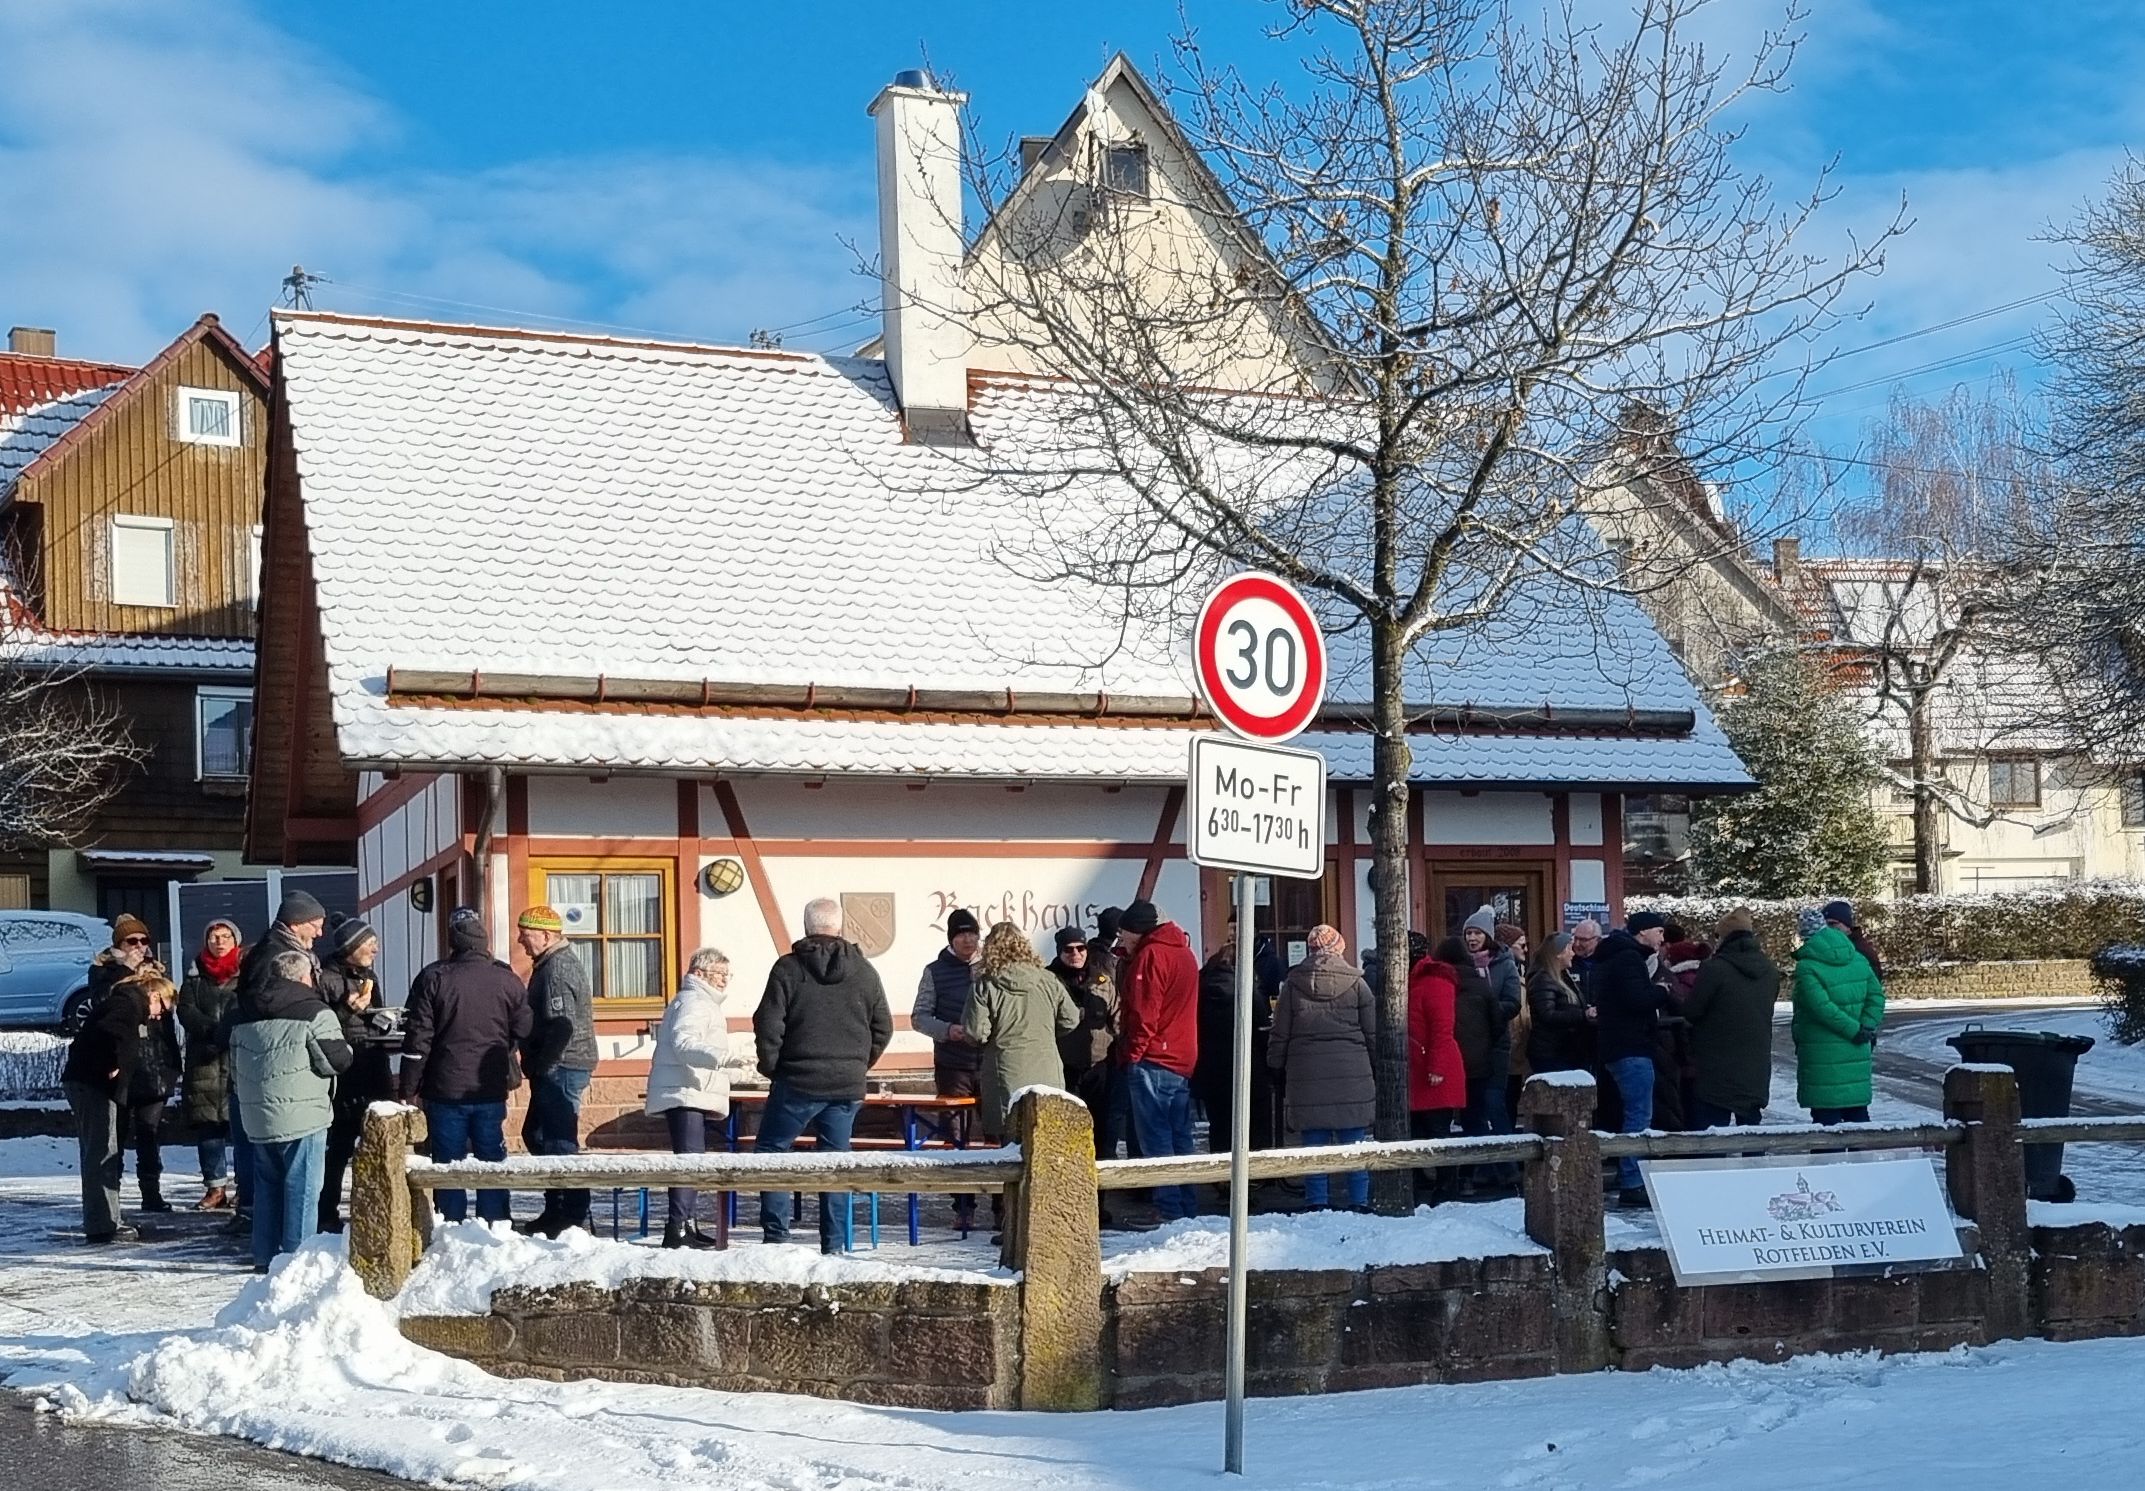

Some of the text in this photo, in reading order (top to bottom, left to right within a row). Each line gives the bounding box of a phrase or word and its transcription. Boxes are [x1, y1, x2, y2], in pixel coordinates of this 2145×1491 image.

[1226, 619, 1296, 697] 30
[1216, 765, 1302, 806] Mo-Fr
[1298, 819, 1309, 850] h
[1563, 902, 1610, 912] Deutschland
[1698, 1218, 1927, 1246] HEIMAT- & KULTURVEREIN
[1753, 1240, 1890, 1265] ROTFELDEN E.V.
